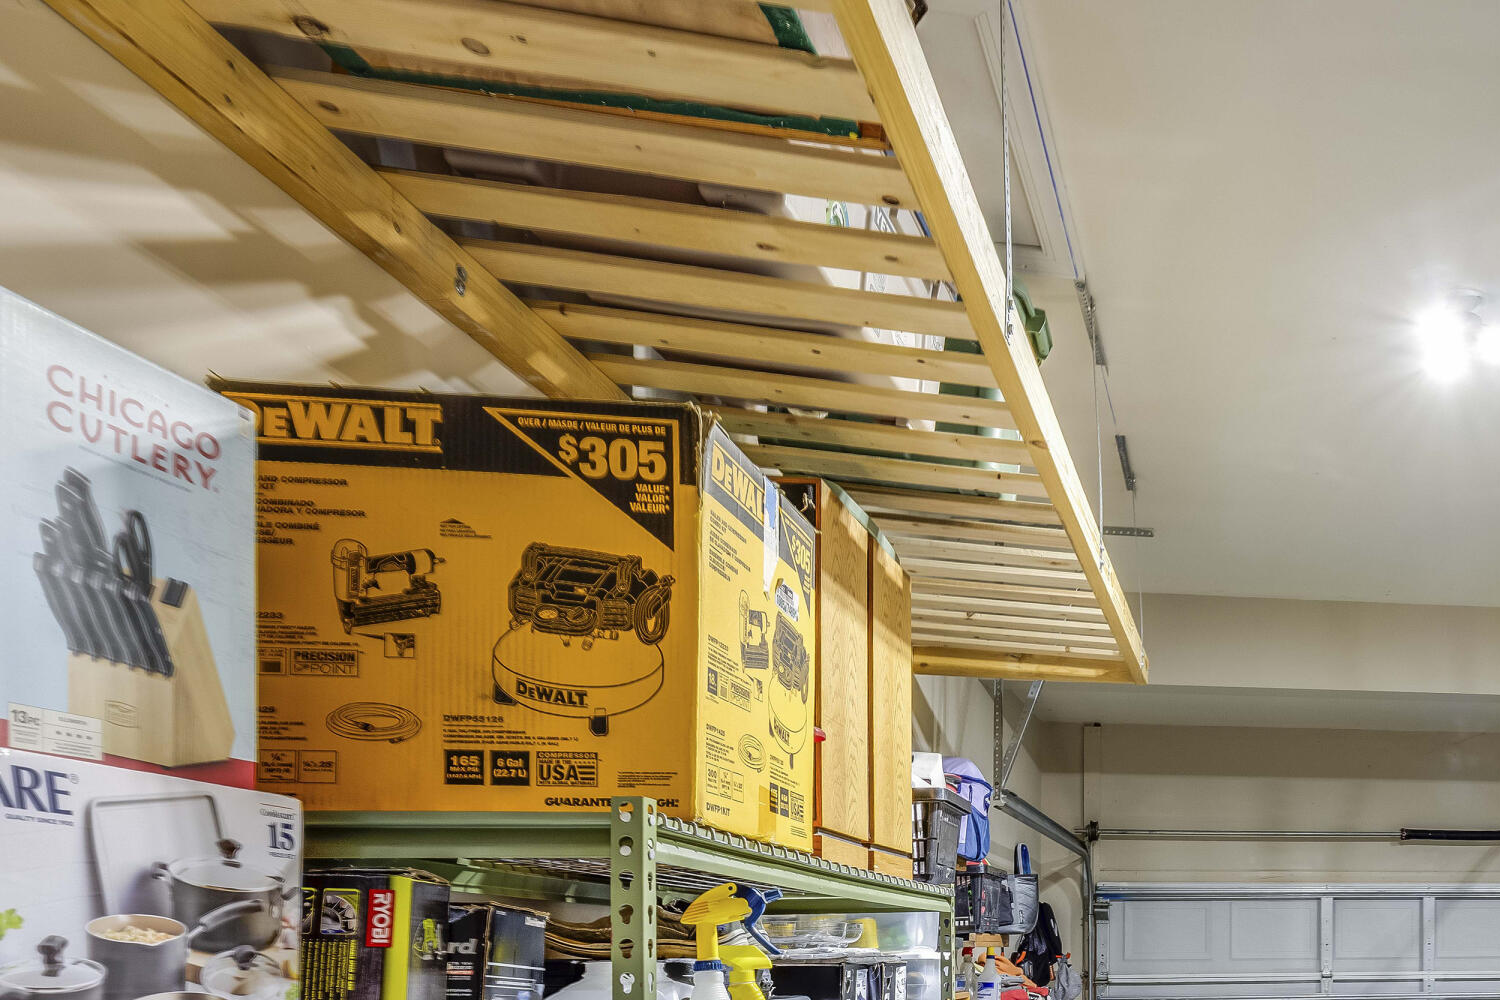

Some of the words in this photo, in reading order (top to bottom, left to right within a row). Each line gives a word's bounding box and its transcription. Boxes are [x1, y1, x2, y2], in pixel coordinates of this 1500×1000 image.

[47, 364, 222, 460] CHICAGO
[517, 416, 541, 428] OVER
[585, 421, 617, 433] VALEUR
[619, 423, 631, 434] DE
[631, 424, 653, 435] PLUS
[654, 426, 667, 437] DE
[47, 400, 218, 491] CUTLERY
[558, 432, 667, 483] $305
[791, 534, 811, 575] $305
[294, 650, 355, 663] PRECISION
[309, 663, 355, 675] POINT
[450, 755, 480, 767] 165
[496, 757, 505, 768] 6
[538, 752, 597, 760] COMPRESSOR
[538, 764, 580, 781] USA
[266, 822, 296, 851] 15
[370, 892, 393, 944] RYOBI
